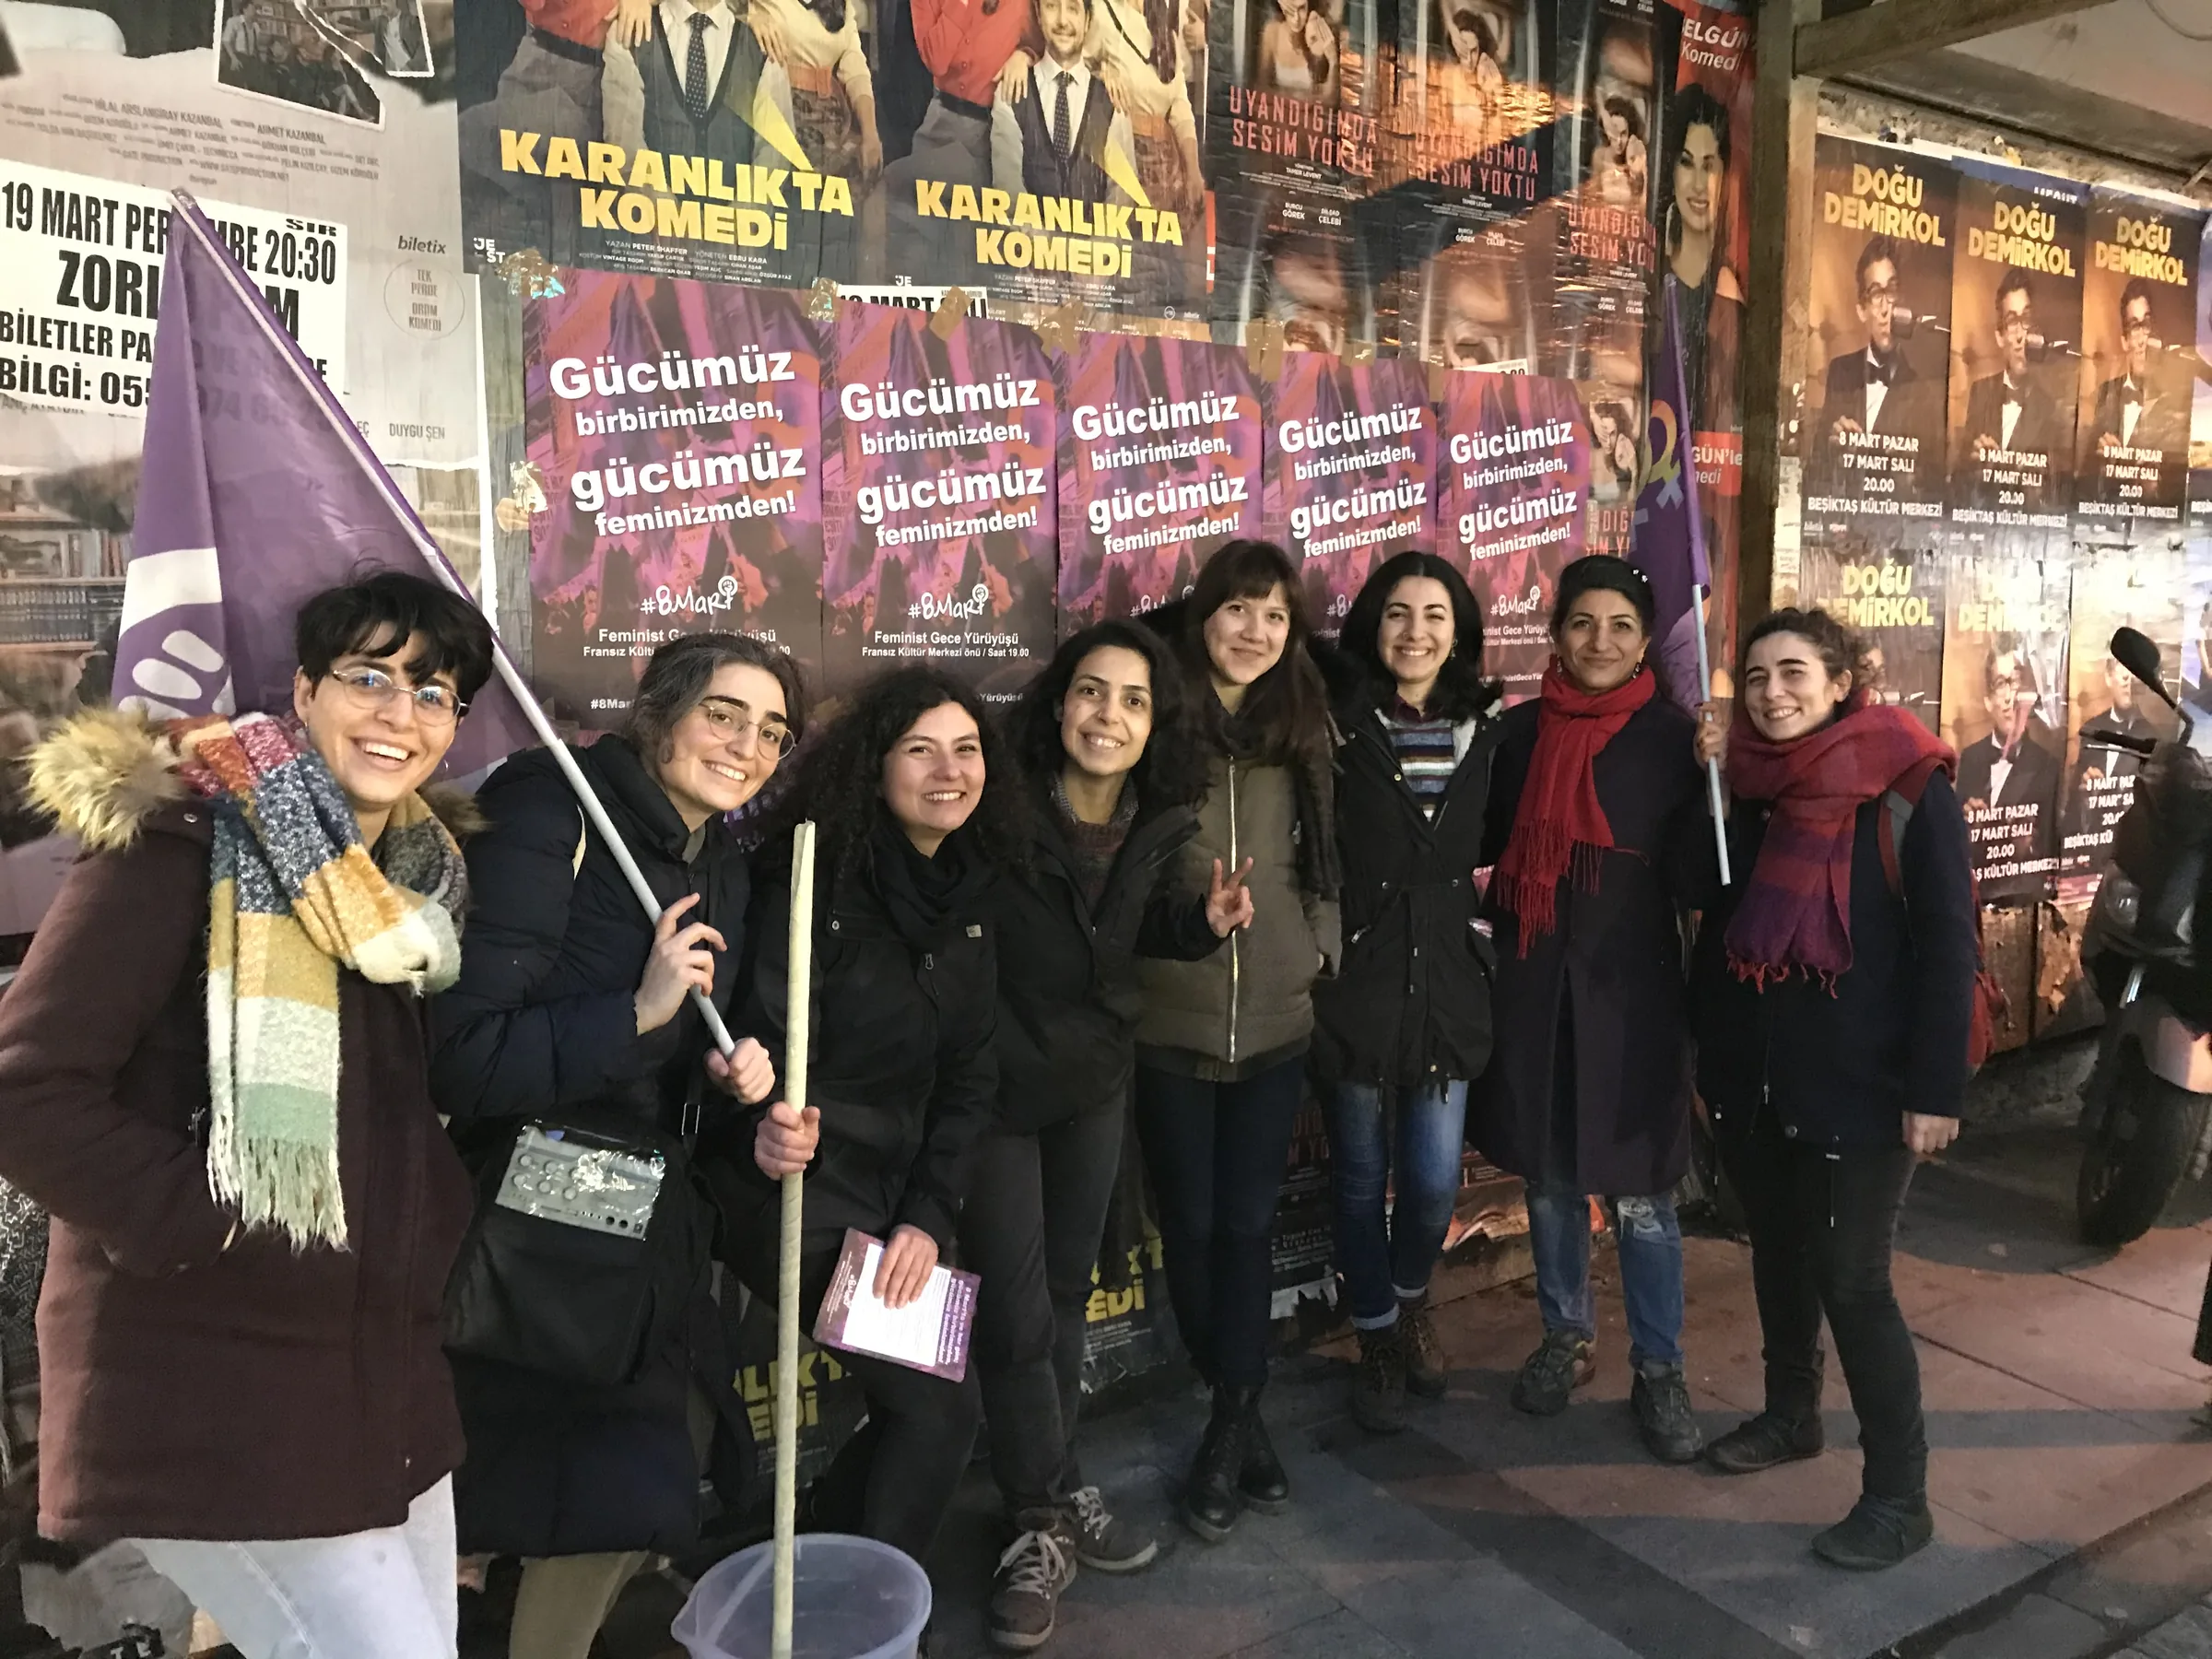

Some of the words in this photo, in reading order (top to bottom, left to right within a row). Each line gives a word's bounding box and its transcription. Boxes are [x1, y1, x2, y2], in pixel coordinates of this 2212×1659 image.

[1682, 18, 1750, 49] ELGÜN
[257, 124, 284, 138] AHMET
[1232, 118, 1298, 158] SESİM
[1479, 167, 1535, 201] YOKTU
[1853, 163, 1924, 207] DOĞU
[286, 218, 336, 237] SIR
[581, 187, 788, 252] KOMEDİ
[1282, 209, 1305, 220] GÖREK
[1318, 215, 1342, 226] ÇELEBİ
[1824, 192, 1946, 247] DEMİRKOL
[1994, 202, 2055, 241] DOĞU
[2, 182, 33, 231] 19
[41, 187, 119, 247] MART
[125, 202, 258, 272] PERMBE
[265, 229, 336, 285] 20:30
[398, 235, 446, 254] biletix
[2116, 217, 2171, 253] DOĞU
[603, 254, 627, 263] VINTAGE
[606, 241, 630, 249] YAZAN
[632, 242, 655, 252] PETER
[656, 245, 688, 255] SHAFFER
[728, 253, 747, 263] EBRU
[748, 256, 768, 265] KARA
[975, 229, 1132, 279] KOMEDİ
[1969, 227, 2076, 277] DEMİRKOL
[2095, 241, 2188, 286] DEMİRKOL
[411, 282, 438, 298] PERDE
[417, 269, 432, 283] TEK
[0, 307, 112, 358] BİLETLER
[0, 355, 90, 401] BİLGİ:
[551, 345, 794, 400] Gücümüz
[841, 373, 1040, 422] Gücümüz
[390, 423, 423, 439] DUYGU
[426, 425, 445, 442] ŞEN
[576, 397, 783, 436] birbirimizden,
[1072, 391, 1239, 441] Gücümüz
[1278, 403, 1422, 453] Gücümüz
[861, 423, 1030, 456] birbirimizden,
[1091, 435, 1231, 472] birbirimizden,
[1450, 418, 1573, 465] Gücümüz
[1840, 431, 1846, 446] 8
[1849, 432, 1881, 449] MART
[1883, 435, 1919, 452] PAZAR
[2111, 446, 2135, 460] MART
[2136, 448, 2163, 463] PAZAR
[1294, 443, 1416, 481] birbirimizden,
[1463, 455, 1568, 491] birbirimizden,
[1843, 453, 1854, 468] 17
[1857, 455, 1888, 471] MART
[1891, 457, 1914, 473] SALI
[1979, 448, 1986, 462] 8
[1988, 449, 2015, 465] MART
[2016, 452, 2047, 467] PAZAR
[2105, 465, 2114, 477] 17
[2115, 465, 2139, 479] MART
[2140, 467, 2158, 481] SALI
[571, 442, 806, 512] gücümüz
[857, 462, 1046, 524] gücümüz
[1864, 477, 1895, 492] 20.00
[1983, 469, 1993, 482] 17
[1994, 470, 2020, 485] MART
[2021, 472, 2042, 487] SALI
[594, 490, 795, 536] feminizmden!
[1088, 472, 1249, 535] gücümüz
[1290, 478, 1427, 540] gücümüz
[1458, 488, 1578, 545] gücümüz
[1807, 495, 1858, 515] BEŞİKTAŞ
[1860, 498, 1900, 515] KÜLTÜR
[1901, 501, 1943, 518] MERKEZİ
[1952, 507, 1994, 525] BEŞİKTAŞ
[1996, 509, 2028, 525] KÜLTÜR
[877, 506, 1038, 547] feminizmden!
[1103, 514, 1240, 555] feminizmden!
[1303, 514, 1422, 559] feminizmden!
[1470, 523, 1571, 562] feminizmden!
[1843, 559, 1912, 596] DOĞU
[599, 629, 665, 642] Feminist
[875, 631, 927, 644] Feminist
[931, 631, 961, 644] Gece
[964, 632, 1018, 647] Yürüyüşü
[1502, 626, 1522, 636] Gece
[583, 647, 626, 657] Fransız
[629, 646, 654, 657] Kült
[863, 647, 896, 657] Fransız
[898, 647, 925, 657] Kültür
[928, 647, 962, 657] Merkezi
[965, 647, 981, 657] önü
[987, 647, 1006, 657] Saat
[1008, 648, 1030, 657] 19.00
[2087, 778, 2092, 791] 8
[2093, 776, 2118, 791] MART
[2120, 775, 2136, 789] PAZ
[1967, 810, 1974, 823] 8
[1976, 806, 2005, 822] MART
[2006, 803, 2039, 818] PAZAR
[2088, 796, 2097, 809] 17
[1971, 829, 1981, 842] 17
[1982, 825, 2010, 841] MART
[2011, 822, 2033, 837] SALI
[2064, 831, 2099, 850] BEŞİKTAŞ
[1986, 843, 2016, 860] 20.00
[1983, 861, 2018, 879] KÜLTÜR
